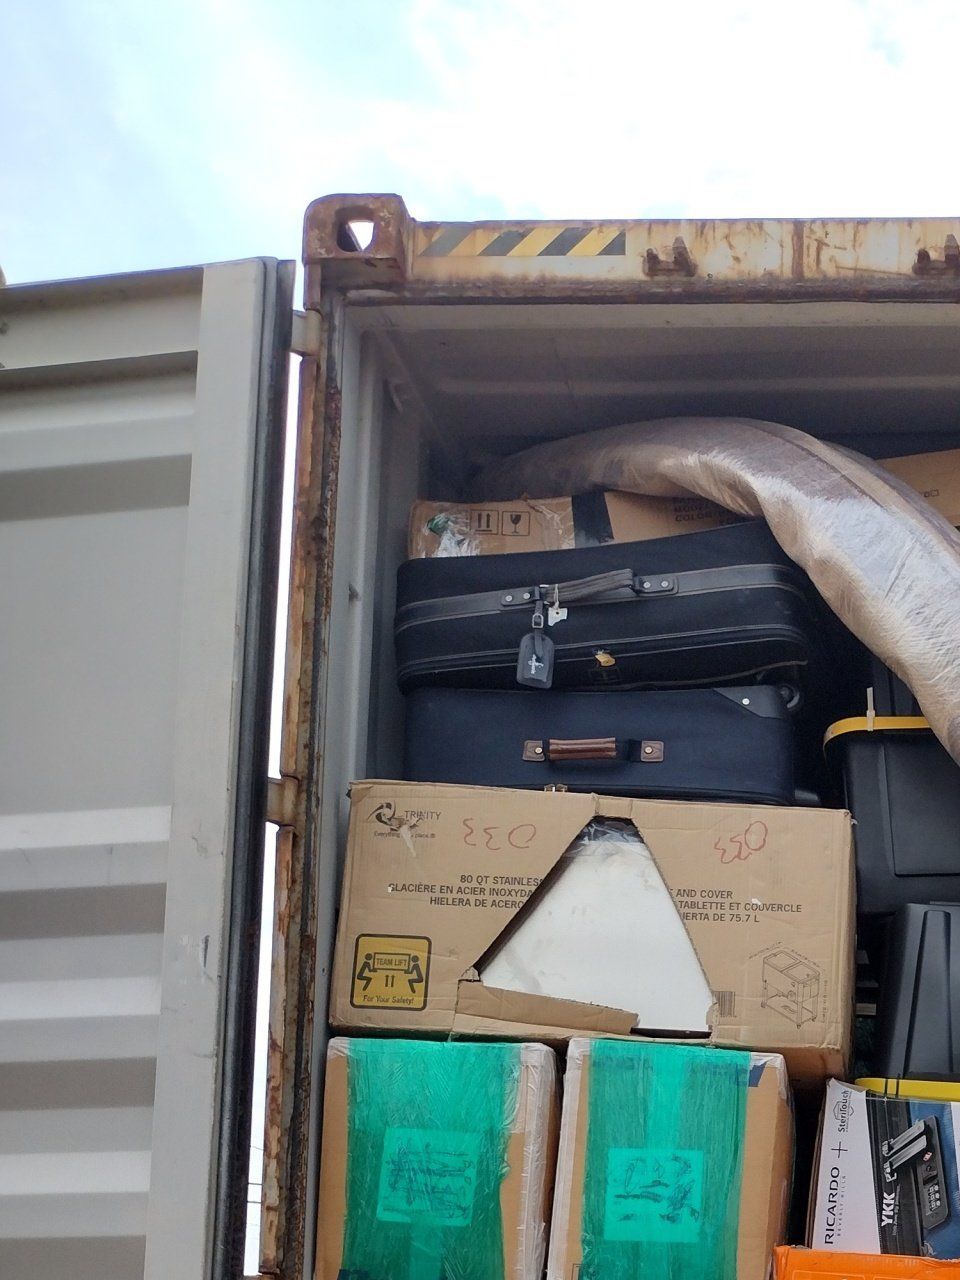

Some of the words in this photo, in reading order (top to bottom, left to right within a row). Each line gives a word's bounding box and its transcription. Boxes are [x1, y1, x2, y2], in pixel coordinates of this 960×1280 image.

[404, 810, 441, 821] TRINITY
[439, 885, 454, 894] EN
[456, 886, 487, 896] ACIER
[678, 900, 726, 911] TABLETTE
[728, 901, 741, 912] ET
[744, 902, 802, 913] COUVERCLE
[460, 874, 473, 884] 80
[476, 874, 490, 885] QT
[676, 888, 697, 899] AND
[700, 889, 733, 900] COVER
[429, 897, 471, 908] HIELERA
[474, 898, 488, 908] DE
[712, 912, 727, 922] DE
[729, 913, 751, 924] 75.7
[754, 913, 760, 923] L
[376, 957, 393, 967] TEAM
[394, 958, 409, 967] LIFT
[363, 994, 374, 1003] For
[375, 995, 391, 1004] Your
[391, 996, 415, 1006] Safety!
[824, 1166, 840, 1245] RICARDO
[881, 1191, 896, 1227] YKK
